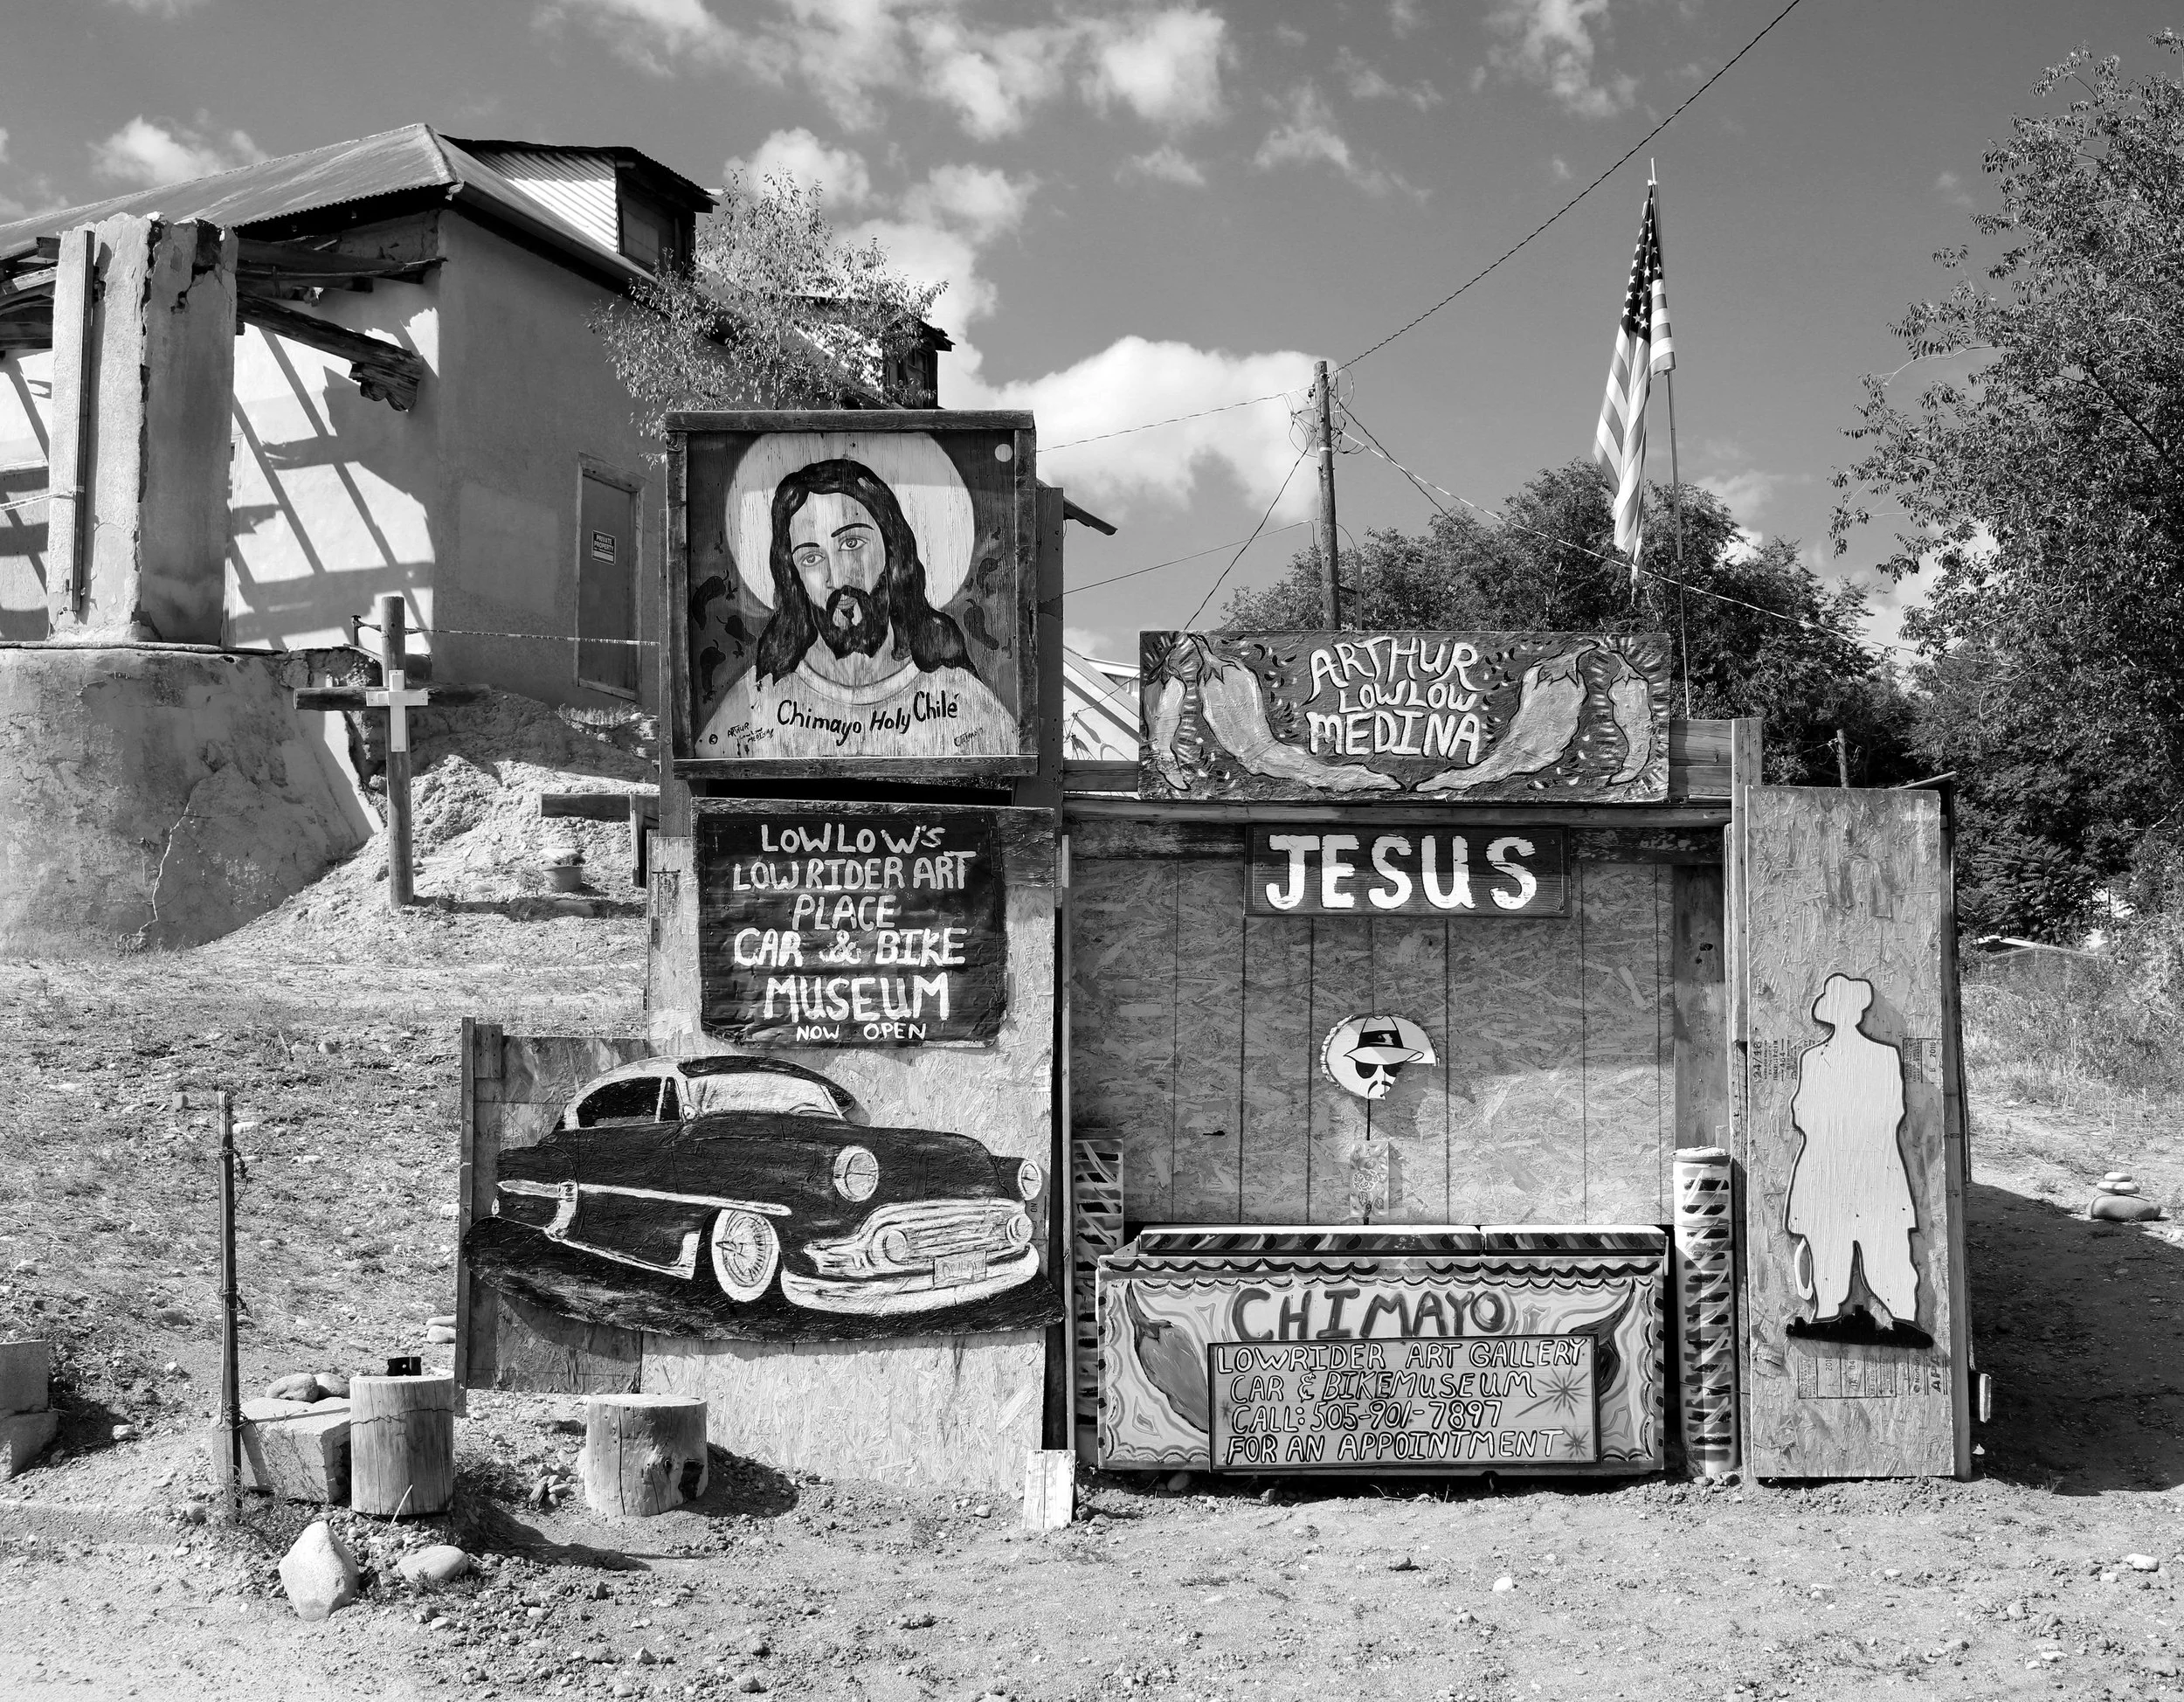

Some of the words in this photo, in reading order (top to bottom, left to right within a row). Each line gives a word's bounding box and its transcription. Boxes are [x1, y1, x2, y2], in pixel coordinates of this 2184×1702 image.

[594, 540, 614, 552] PROPERTY
[596, 534, 612, 545] PRIVATE
[1304, 636, 1484, 706] ARTHUR
[1338, 679, 1477, 714] LOWLOW
[777, 699, 862, 746] Chimayo
[869, 707, 911, 735] Holy
[1305, 709, 1480, 765] MEDINA
[913, 850, 977, 890] ART
[1265, 834, 1537, 910] JESUS
[791, 893, 897, 931] PLACE
[733, 927, 803, 967] CAR
[819, 930, 863, 965] &
[874, 927, 968, 967] BIKE
[763, 972, 951, 1023] MUSEUM
[796, 1024, 840, 1041] NOW
[863, 1021, 927, 1041] OPEN
[1231, 1287, 1506, 1341] CHIMAYO
[1216, 1343, 1386, 1374] LOWRIDER
[1405, 1341, 1463, 1369] ART
[1469, 1338, 1588, 1368] GALLERY
[1230, 1374, 1284, 1404] CAR
[1297, 1369, 1317, 1403] &
[1231, 1405, 1305, 1435] CALL:
[1310, 1399, 1503, 1433] 505-901-7897
[1226, 1434, 1279, 1466] FOR
[1285, 1434, 1326, 1463] AN
[1337, 1429, 1565, 1461] APPOINTMENT
